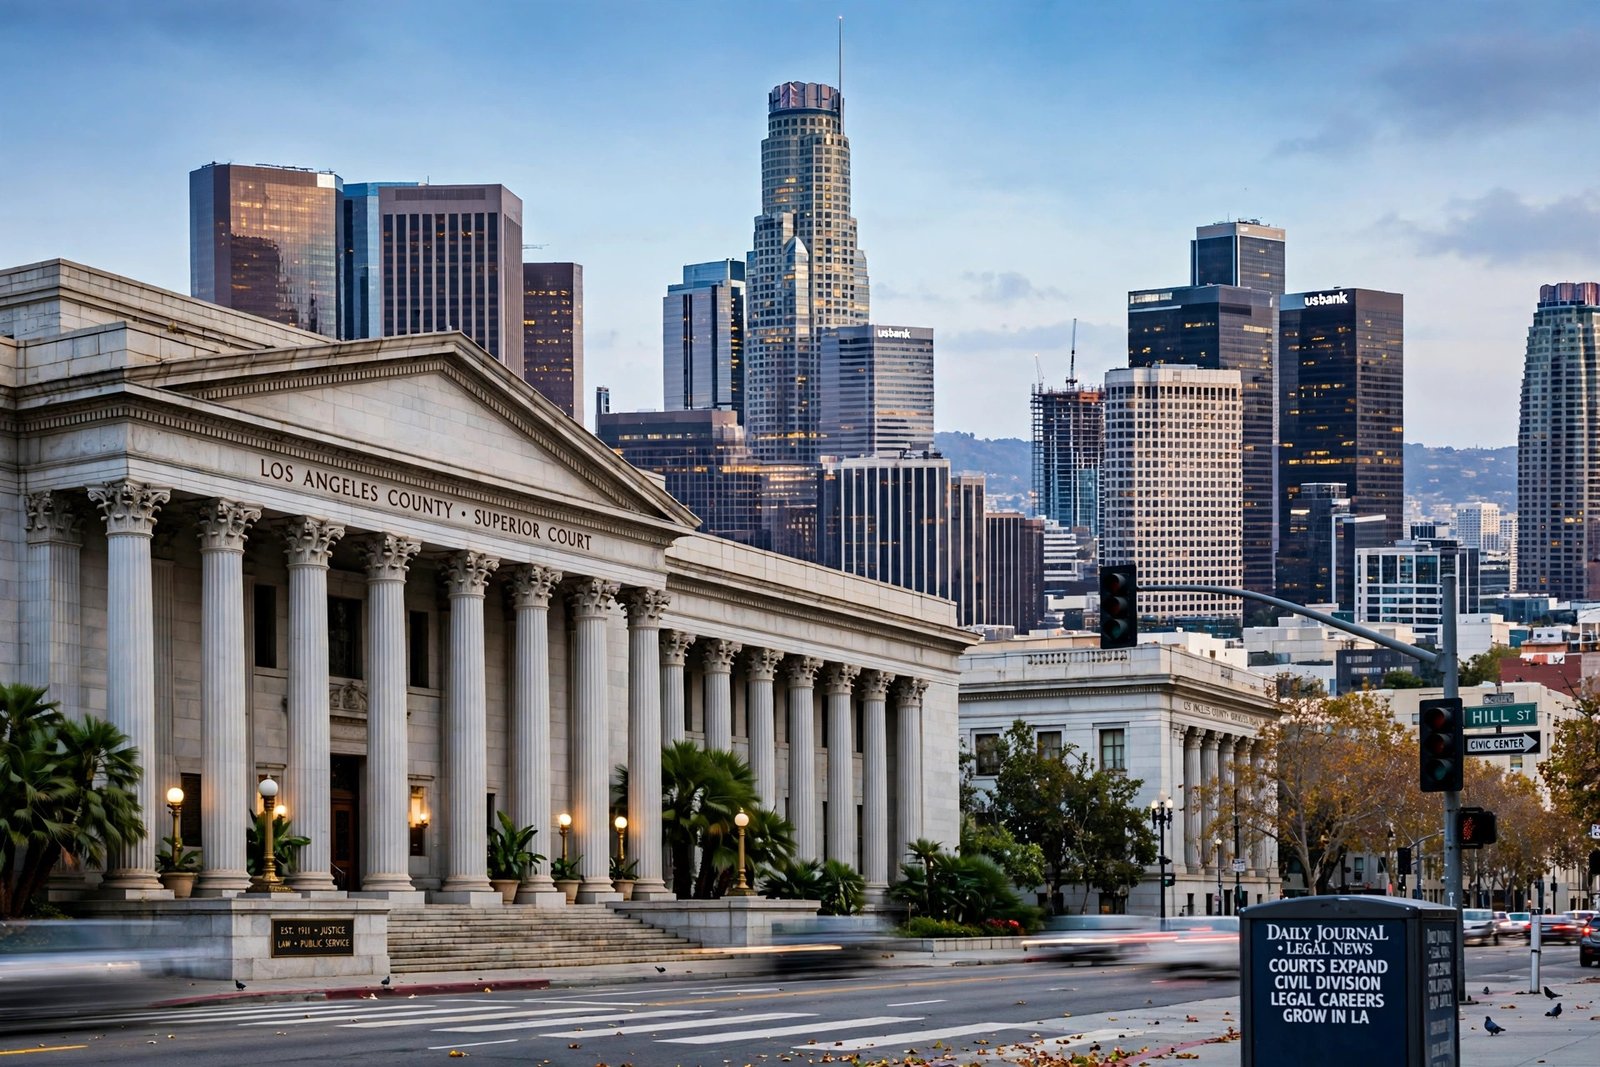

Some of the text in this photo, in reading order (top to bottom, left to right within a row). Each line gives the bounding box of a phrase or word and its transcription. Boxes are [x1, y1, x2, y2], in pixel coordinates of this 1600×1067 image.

[1304, 291, 1348, 306] usbank
[878, 327, 911, 339] usbank
[260, 458, 592, 551] LOS ANGELES COUNTY SUPERIOR COURT
[1472, 709, 1531, 724] HILL ST
[1470, 738, 1524, 750] CIVIC CENTER
[280, 926, 294, 935] EST.
[320, 926, 346, 936] JUSTICE
[1266, 924, 1389, 943] DAILY JOURNAL
[277, 938, 350, 948] LAW PUBLIC SERVICE
[1286, 942, 1373, 955] LEGAL NEWS
[1268, 958, 1388, 974] COURTS EXPAND
[1274, 975, 1381, 991] CIVIL DIVISION
[1270, 992, 1385, 1008] LEGAL CAREERS
[1283, 1009, 1370, 1024] GROW IN LA
